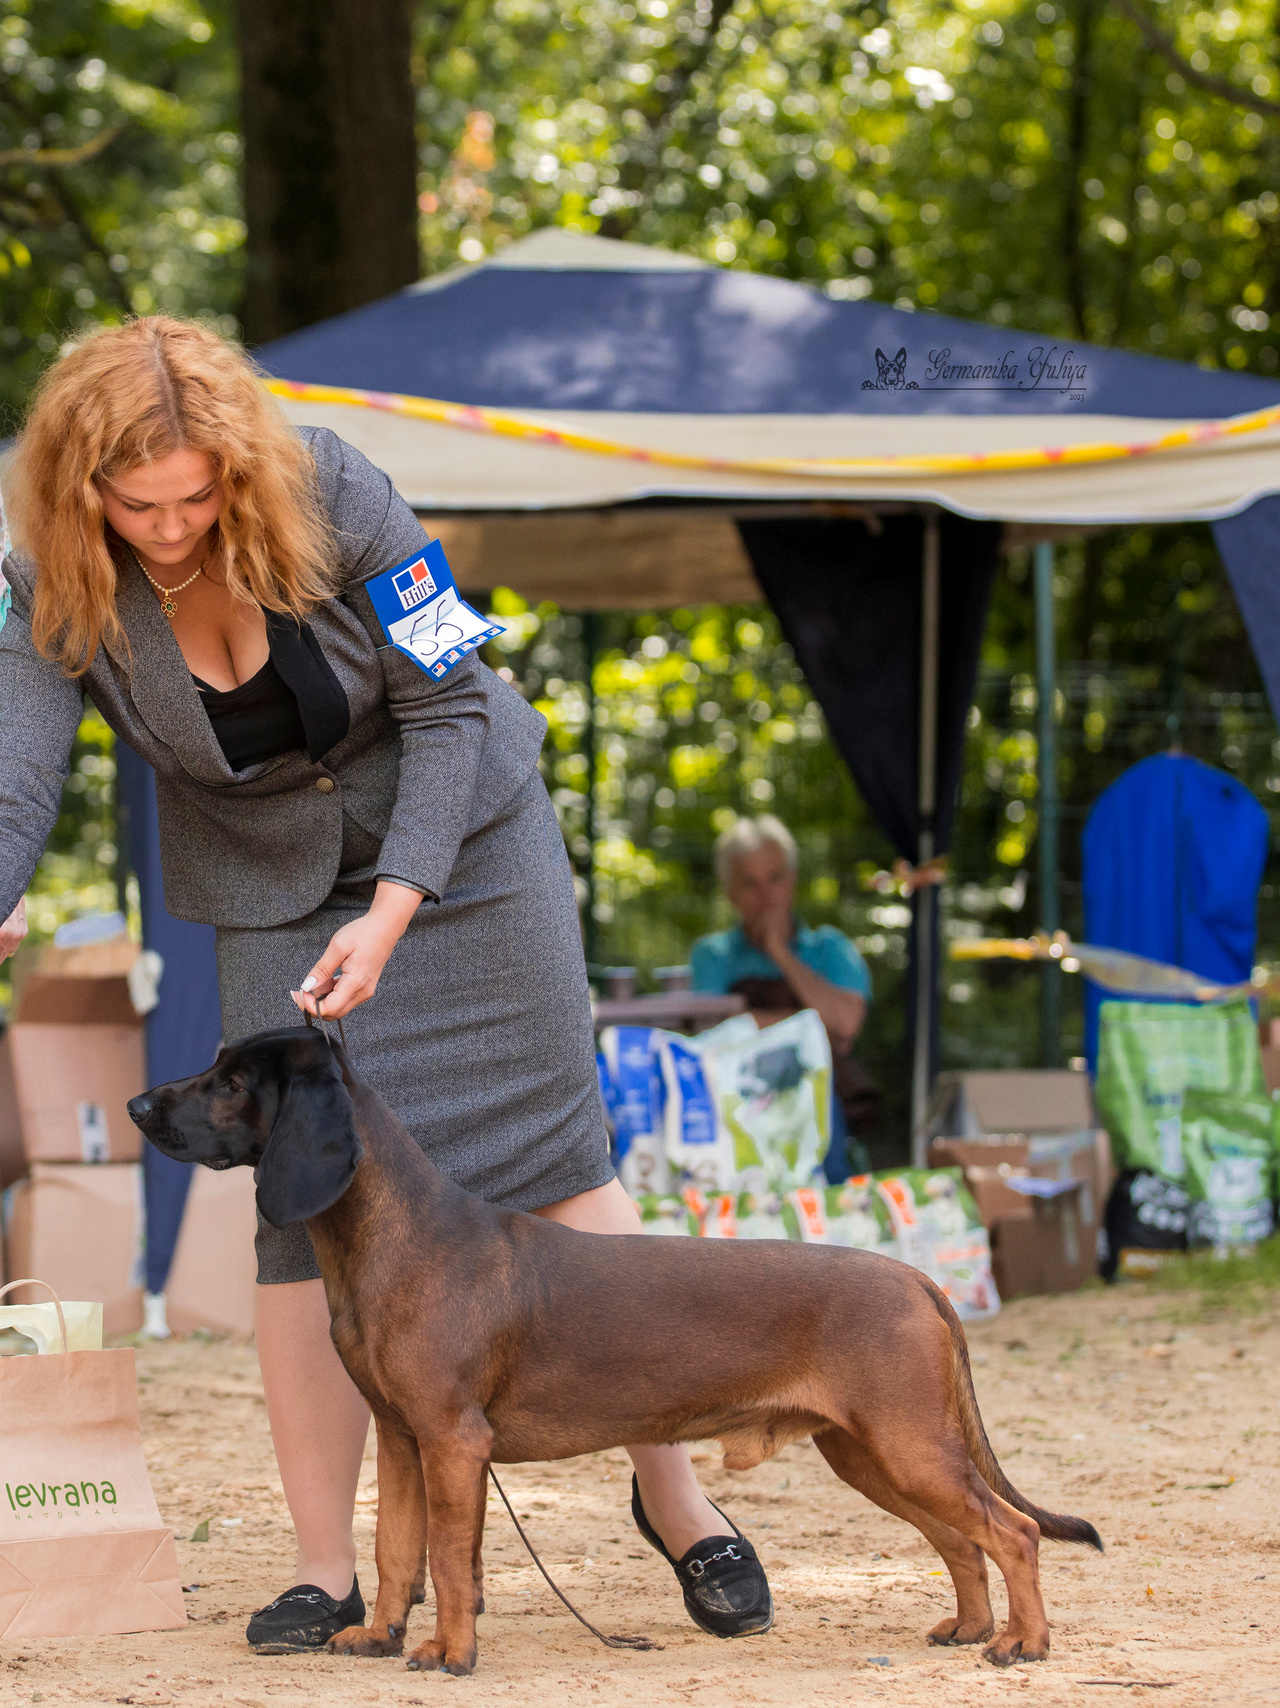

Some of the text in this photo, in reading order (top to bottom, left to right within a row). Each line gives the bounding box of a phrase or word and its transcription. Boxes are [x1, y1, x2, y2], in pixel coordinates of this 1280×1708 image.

[402, 580, 435, 607] Hill's
[410, 599, 464, 656] 55
[5, 1481, 117, 1511] levrana
[15, 1508, 117, 1520] NATURAL
